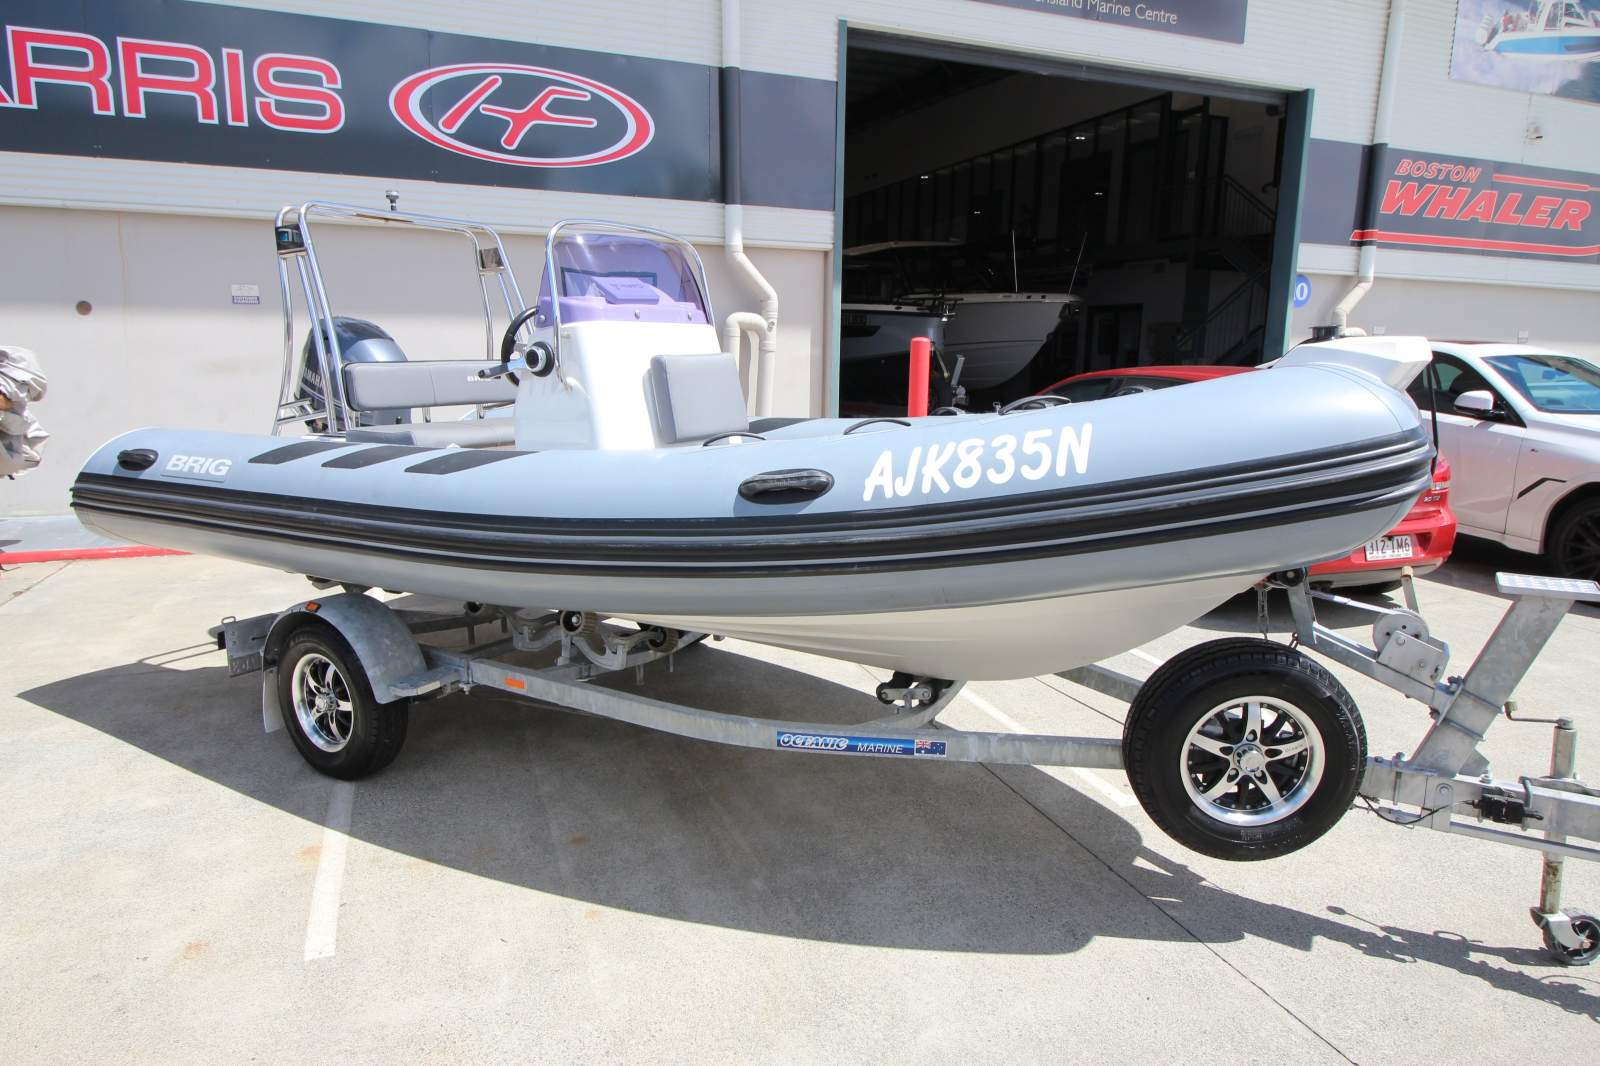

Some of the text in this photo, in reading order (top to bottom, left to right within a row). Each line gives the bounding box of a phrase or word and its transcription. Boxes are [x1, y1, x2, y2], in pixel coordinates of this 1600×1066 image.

[1087, 0, 1131, 17] Marine
[1135, 4, 1178, 25] Centre
[0, 25, 346, 134] RRIS
[1394, 159, 1482, 183] BOSTON
[1380, 179, 1592, 232] WHALER
[1293, 282, 1308, 301] 0
[166, 454, 233, 476] BRIG
[862, 423, 1093, 501] AJK835N
[780, 733, 904, 754] OCEANIC MARINE
